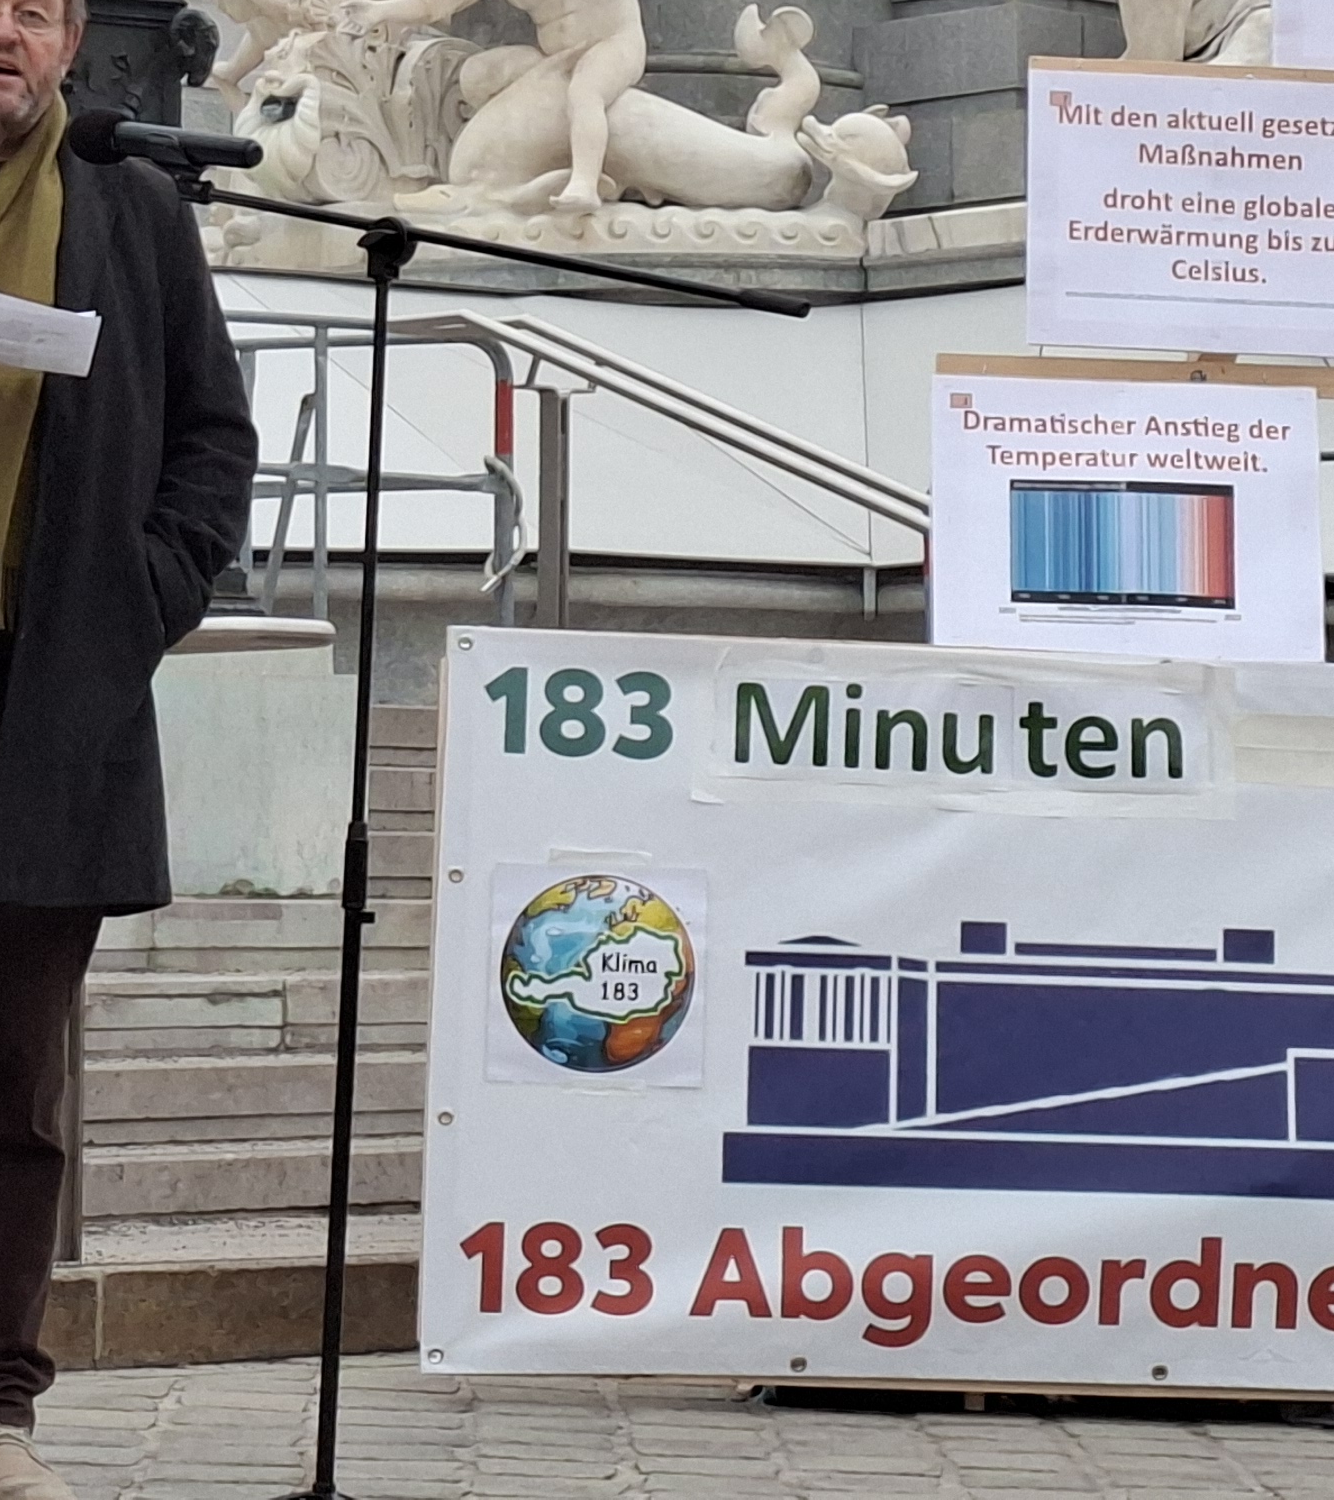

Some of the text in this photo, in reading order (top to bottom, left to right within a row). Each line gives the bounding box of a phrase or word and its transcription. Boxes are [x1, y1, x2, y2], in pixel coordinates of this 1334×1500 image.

[1058, 103, 1102, 126] Mit
[1111, 106, 1157, 128] den
[1167, 110, 1254, 132] aktuell
[1139, 143, 1303, 171] Maßnahmen
[1104, 188, 1173, 212] droht
[1181, 193, 1235, 214] eine
[1069, 221, 1258, 254] Erderwärmung
[1268, 229, 1303, 252] bis
[1172, 260, 1267, 284] Celsius.
[964, 410, 1291, 442] Dramatischer Anstieg der
[986, 445, 1268, 473] Temperatur weltweit.
[485, 666, 674, 761] 183
[735, 681, 1184, 779] Minuten
[601, 952, 658, 976] Klima
[600, 981, 640, 1002] 183
[460, 1221, 654, 1315] 183
